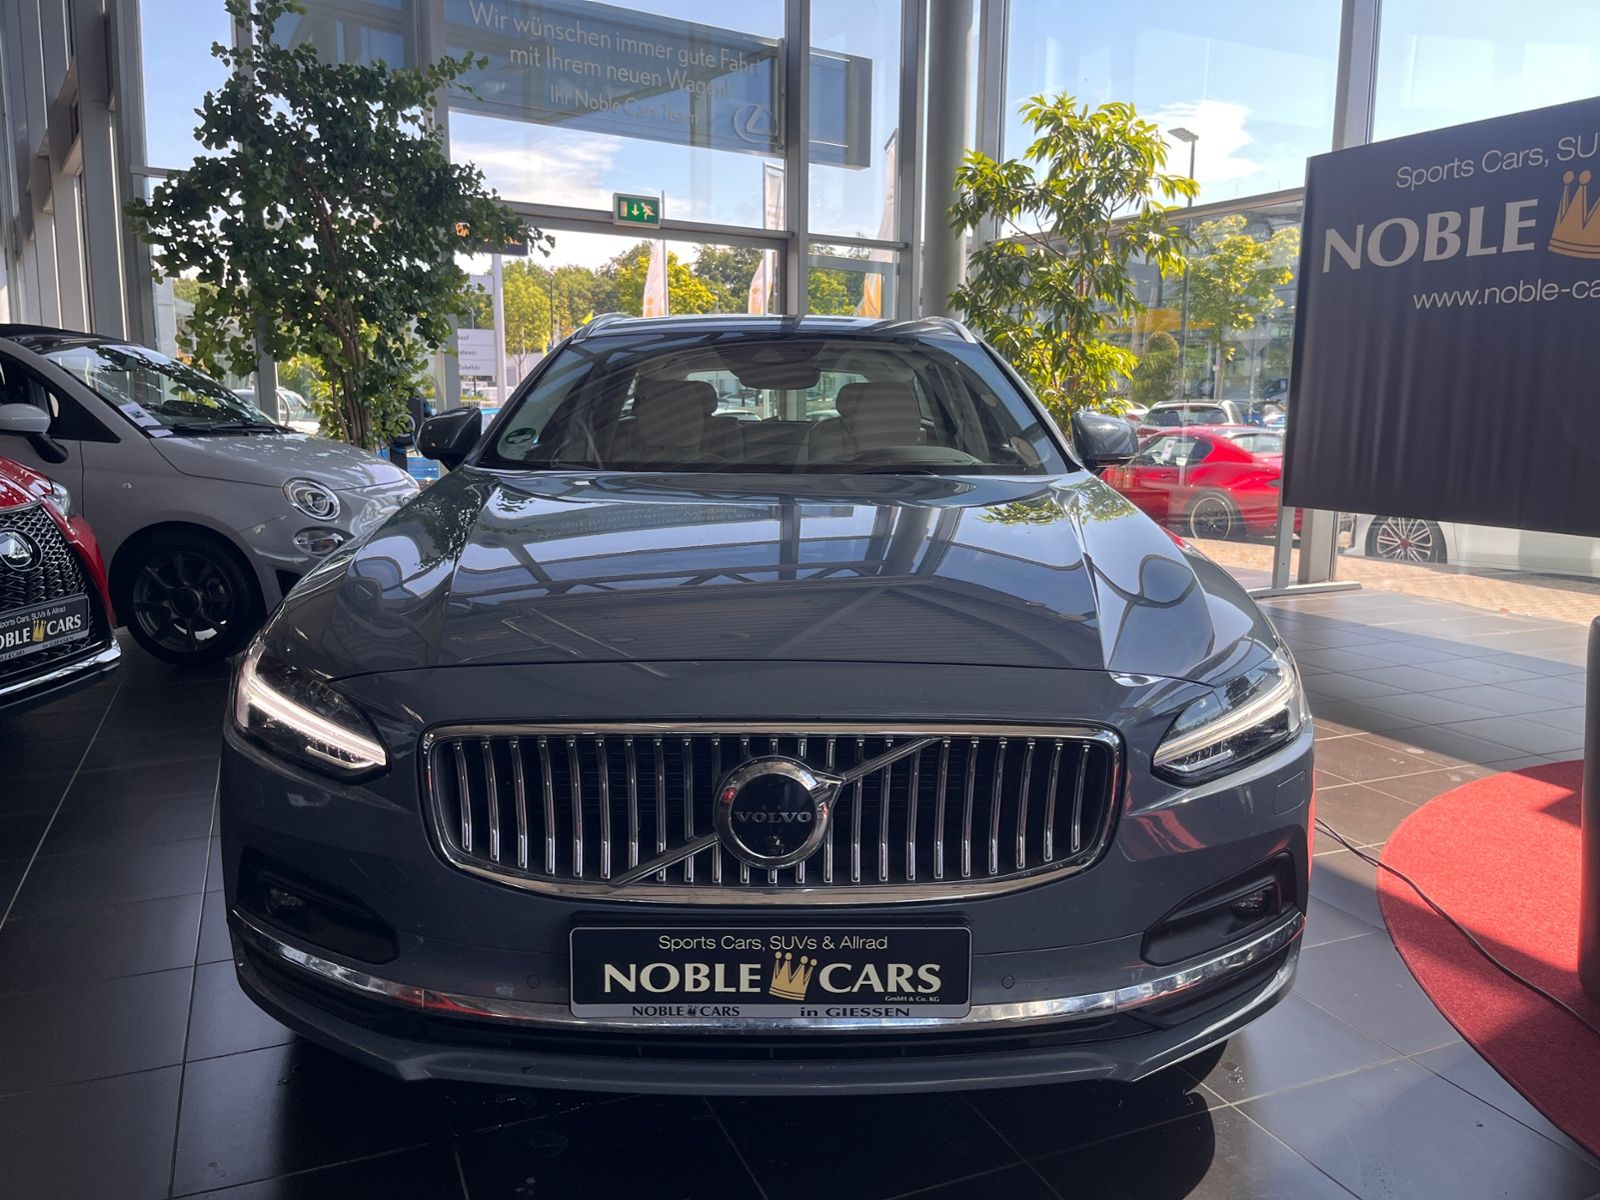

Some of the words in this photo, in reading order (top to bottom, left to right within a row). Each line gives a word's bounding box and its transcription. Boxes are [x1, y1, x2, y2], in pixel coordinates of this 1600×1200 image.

[469, 0, 508, 29] Wir
[513, 16, 611, 49] wünschen
[615, 32, 674, 60] immer
[678, 49, 716, 68] gute
[720, 48, 761, 74] Fahrt
[510, 46, 540, 67] mit
[546, 45, 601, 77] Ihrem
[607, 65, 662, 88] neuen
[550, 85, 571, 105] Ihr
[574, 89, 621, 113] Noble
[1396, 157, 1474, 191] Sports
[1481, 147, 1549, 173] Cars,
[1556, 132, 1600, 161] SU
[1322, 198, 1539, 274] NOBLE
[0, 618, 16, 628] ports
[31, 611, 46, 620] SUVs
[0, 627, 31, 650] BLE
[46, 614, 82, 635] CARS
[733, 811, 812, 823] VOLVO
[658, 935, 717, 952] Sports
[721, 935, 766, 952] Cars,
[769, 935, 818, 950] SUVs
[821, 935, 836, 950] &
[839, 935, 888, 950] Allrad
[604, 962, 762, 993] NOBLE
[818, 962, 942, 994] CARS
[632, 1006, 684, 1017] NOBLE
[699, 1006, 741, 1017] CARS
[800, 1006, 818, 1017] in
[825, 1007, 910, 1017] GIESSEN
